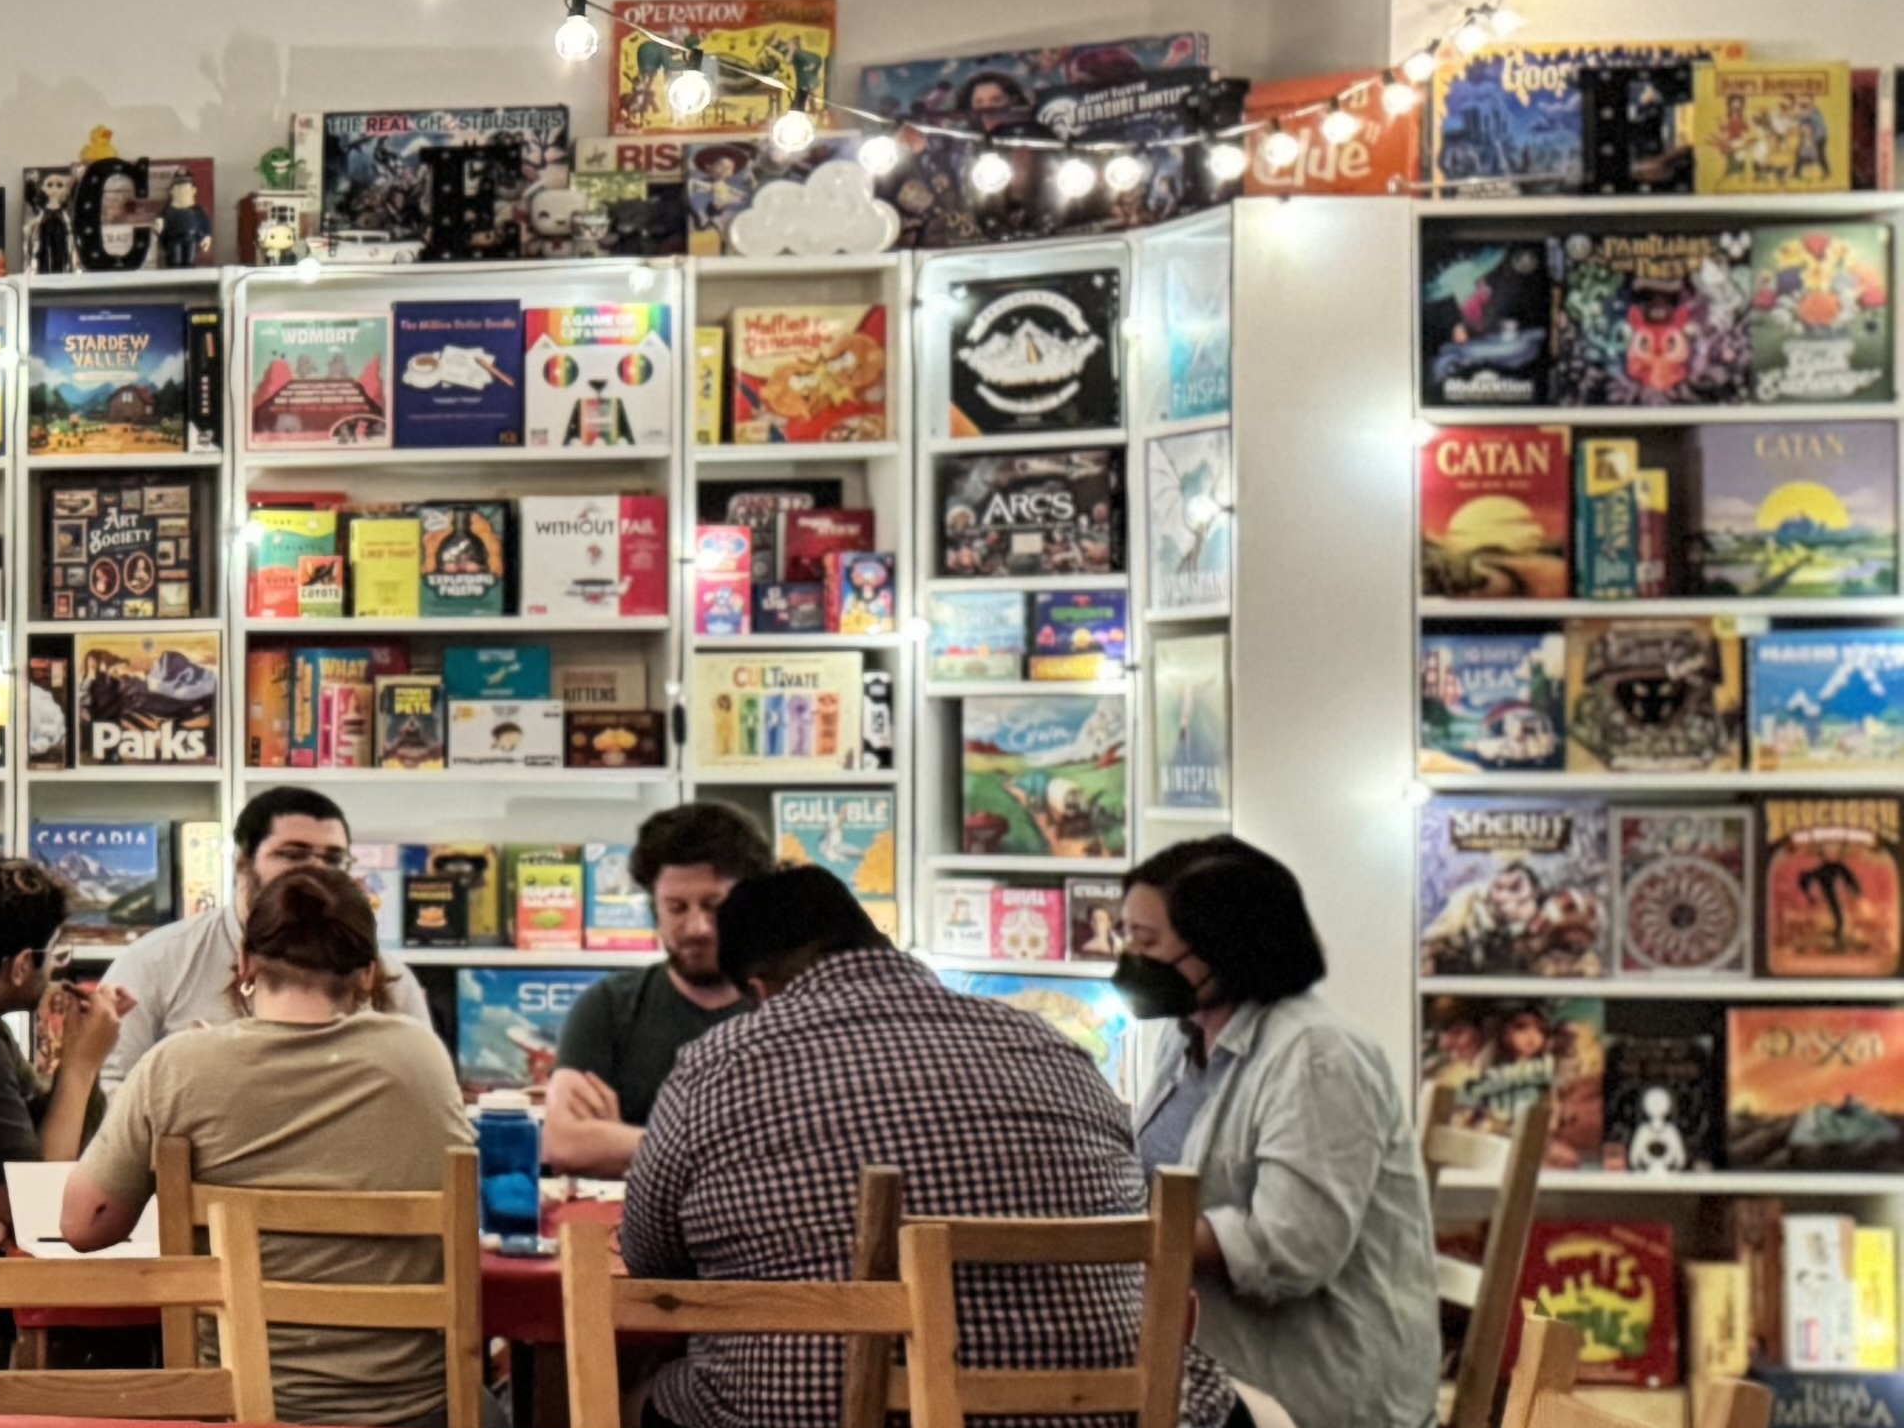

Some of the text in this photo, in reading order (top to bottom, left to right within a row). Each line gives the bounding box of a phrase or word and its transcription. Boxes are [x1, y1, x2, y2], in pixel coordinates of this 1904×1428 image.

[622, 2, 748, 25] OPERATION
[1137, 85, 1191, 112] HUNTER
[365, 114, 414, 133] REAL
[615, 143, 683, 171] RIS
[63, 334, 151, 354] STARDEW
[281, 328, 359, 345] WOMBAT
[71, 349, 140, 368] VALLEY
[1171, 377, 1229, 410] FINSPA
[1436, 441, 1551, 476] CATAN
[1755, 433, 1845, 461] CATAN
[103, 507, 138, 529] ART
[983, 492, 1075, 525] ARCS
[89, 525, 153, 554] SOCIETY
[534, 519, 615, 537] WITHOUT
[301, 588, 340, 599] COYOTE
[731, 665, 822, 691] CULTIVATE
[1463, 668, 1517, 690] USA
[92, 721, 206, 762] Parks
[782, 798, 889, 823] GULLIBLE
[35, 828, 148, 846] CASCADIA
